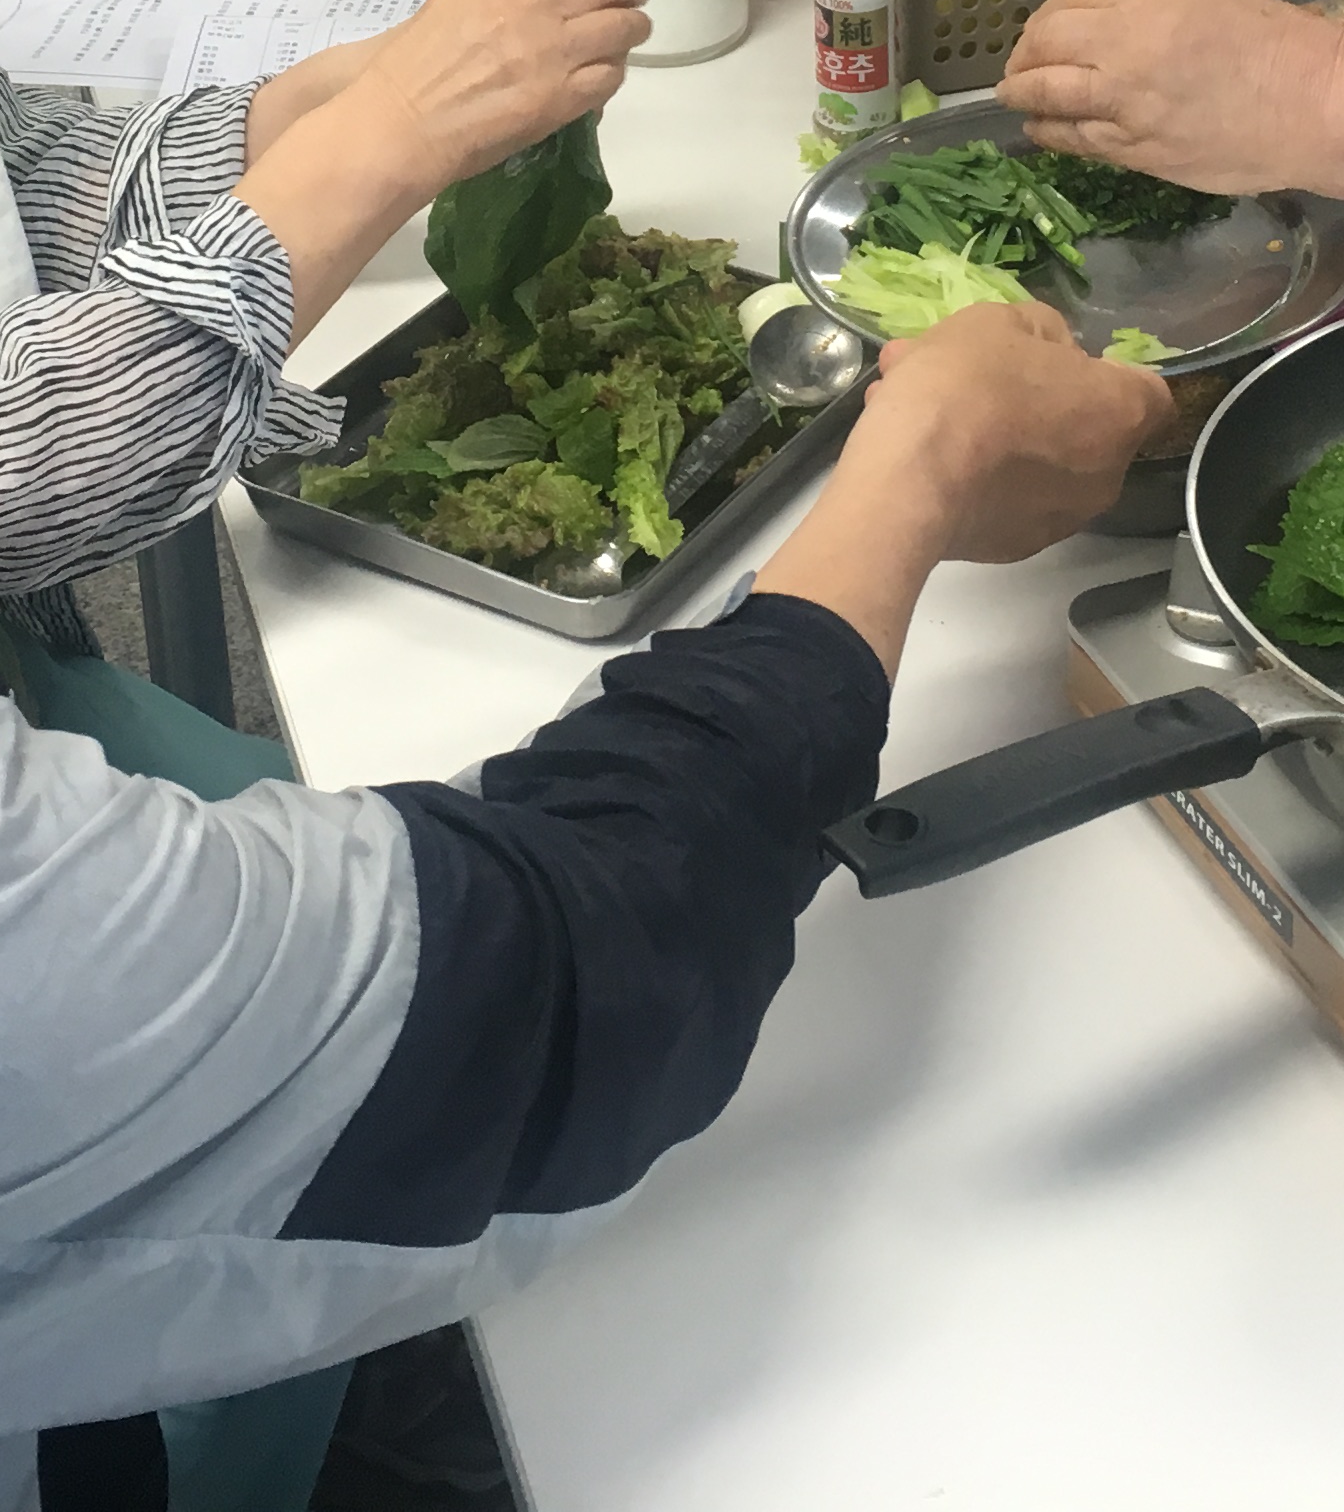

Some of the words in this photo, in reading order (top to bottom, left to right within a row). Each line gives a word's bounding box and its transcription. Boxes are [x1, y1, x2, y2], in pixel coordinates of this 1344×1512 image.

[839, 17, 873, 47] 純
[1171, 790, 1225, 857] RATER
[1227, 851, 1283, 926] SLIM-2
